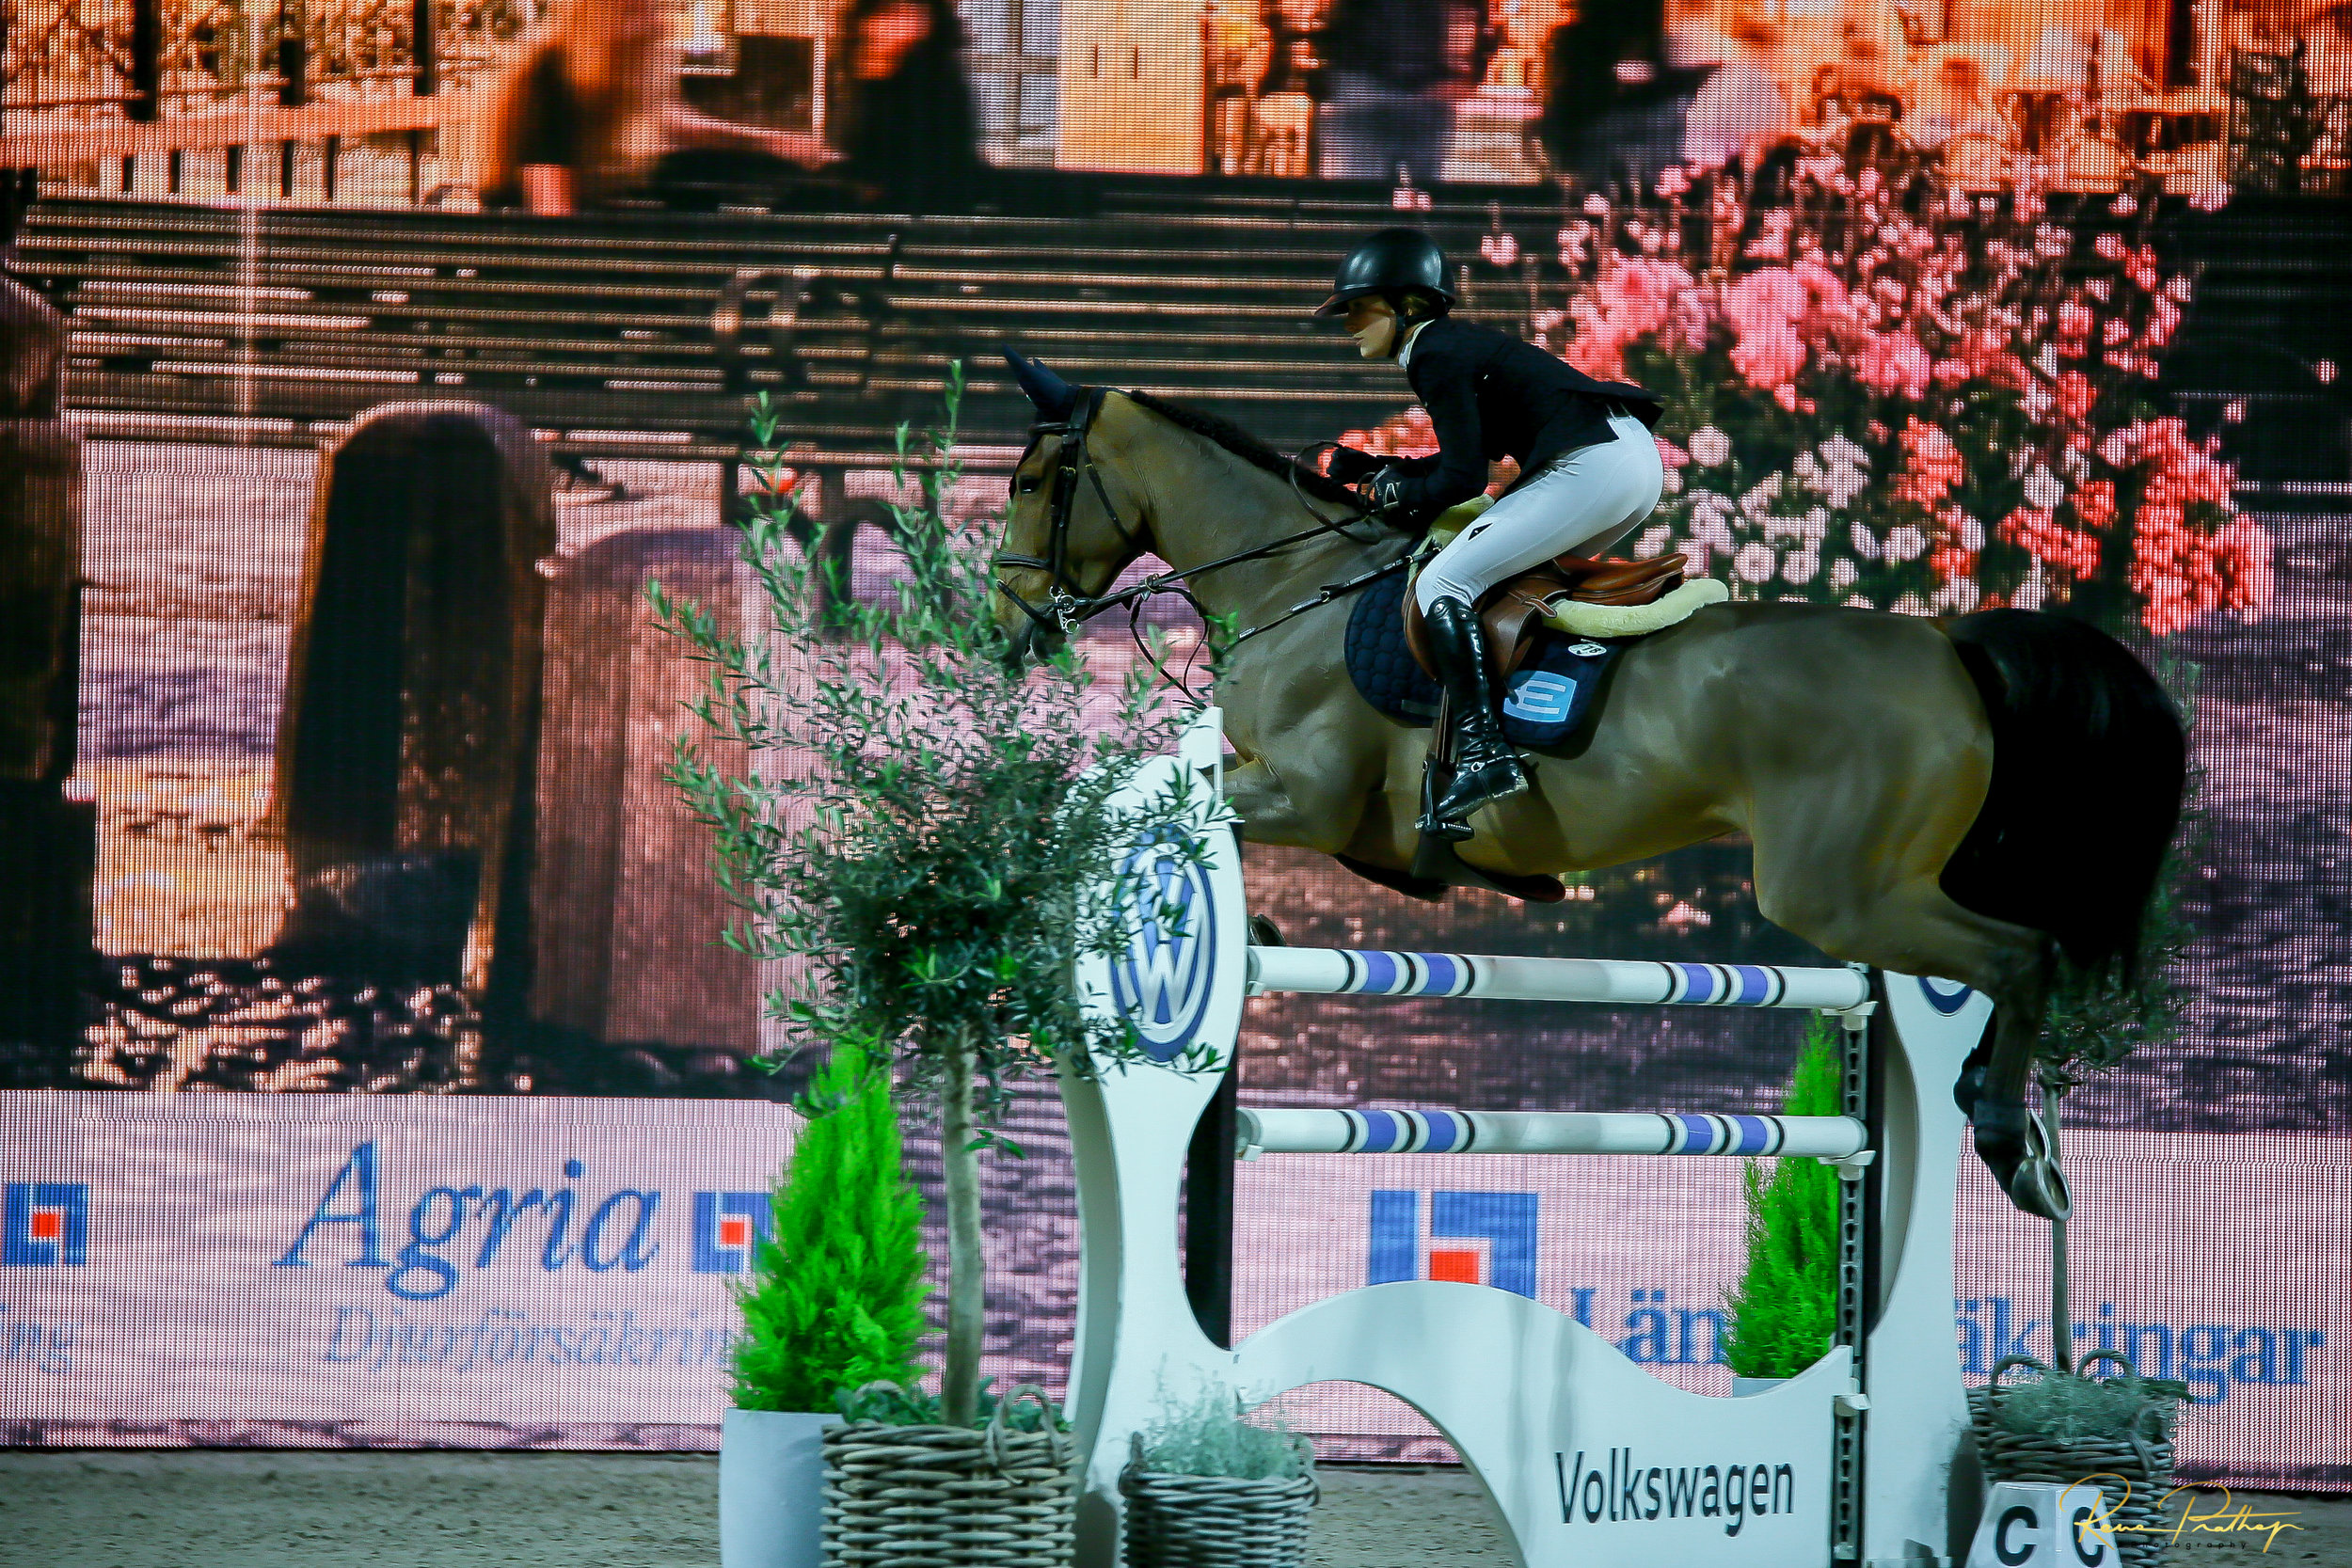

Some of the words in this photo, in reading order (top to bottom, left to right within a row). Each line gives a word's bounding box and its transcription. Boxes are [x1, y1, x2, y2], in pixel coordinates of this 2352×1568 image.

[272, 1140, 661, 1301] Agria
[326, 1307, 733, 1373] Djurförsäkrin
[1554, 1447, 1797, 1538] Volkswagen
[1994, 1505, 2039, 1567] C
[2072, 1506, 2106, 1568] C
